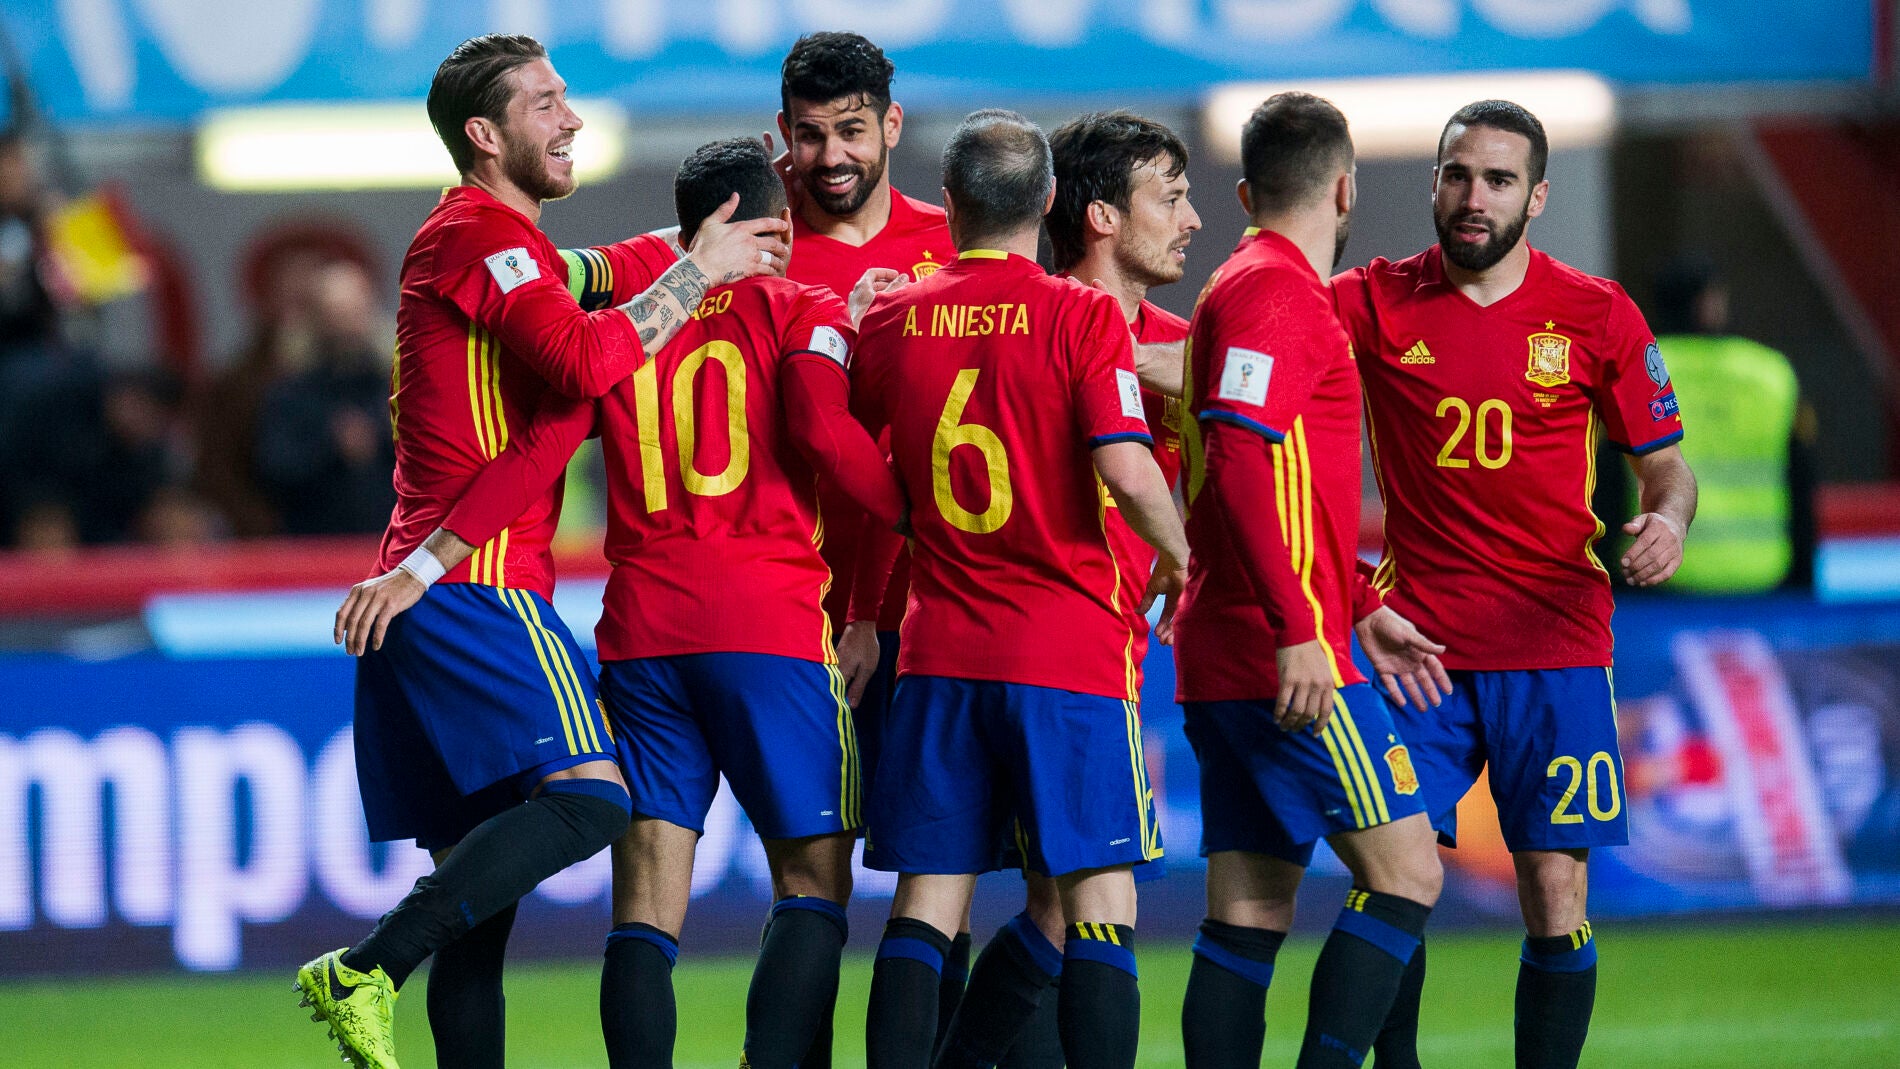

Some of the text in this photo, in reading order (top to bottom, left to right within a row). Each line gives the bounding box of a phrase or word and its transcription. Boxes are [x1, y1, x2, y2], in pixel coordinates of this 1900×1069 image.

[902, 303, 1029, 338] A. INIESTA
[1400, 355, 1436, 365] adidas
[633, 340, 750, 514] 10
[932, 368, 1013, 534] 6
[1435, 396, 1513, 470] 20
[1546, 750, 1622, 825] 20
